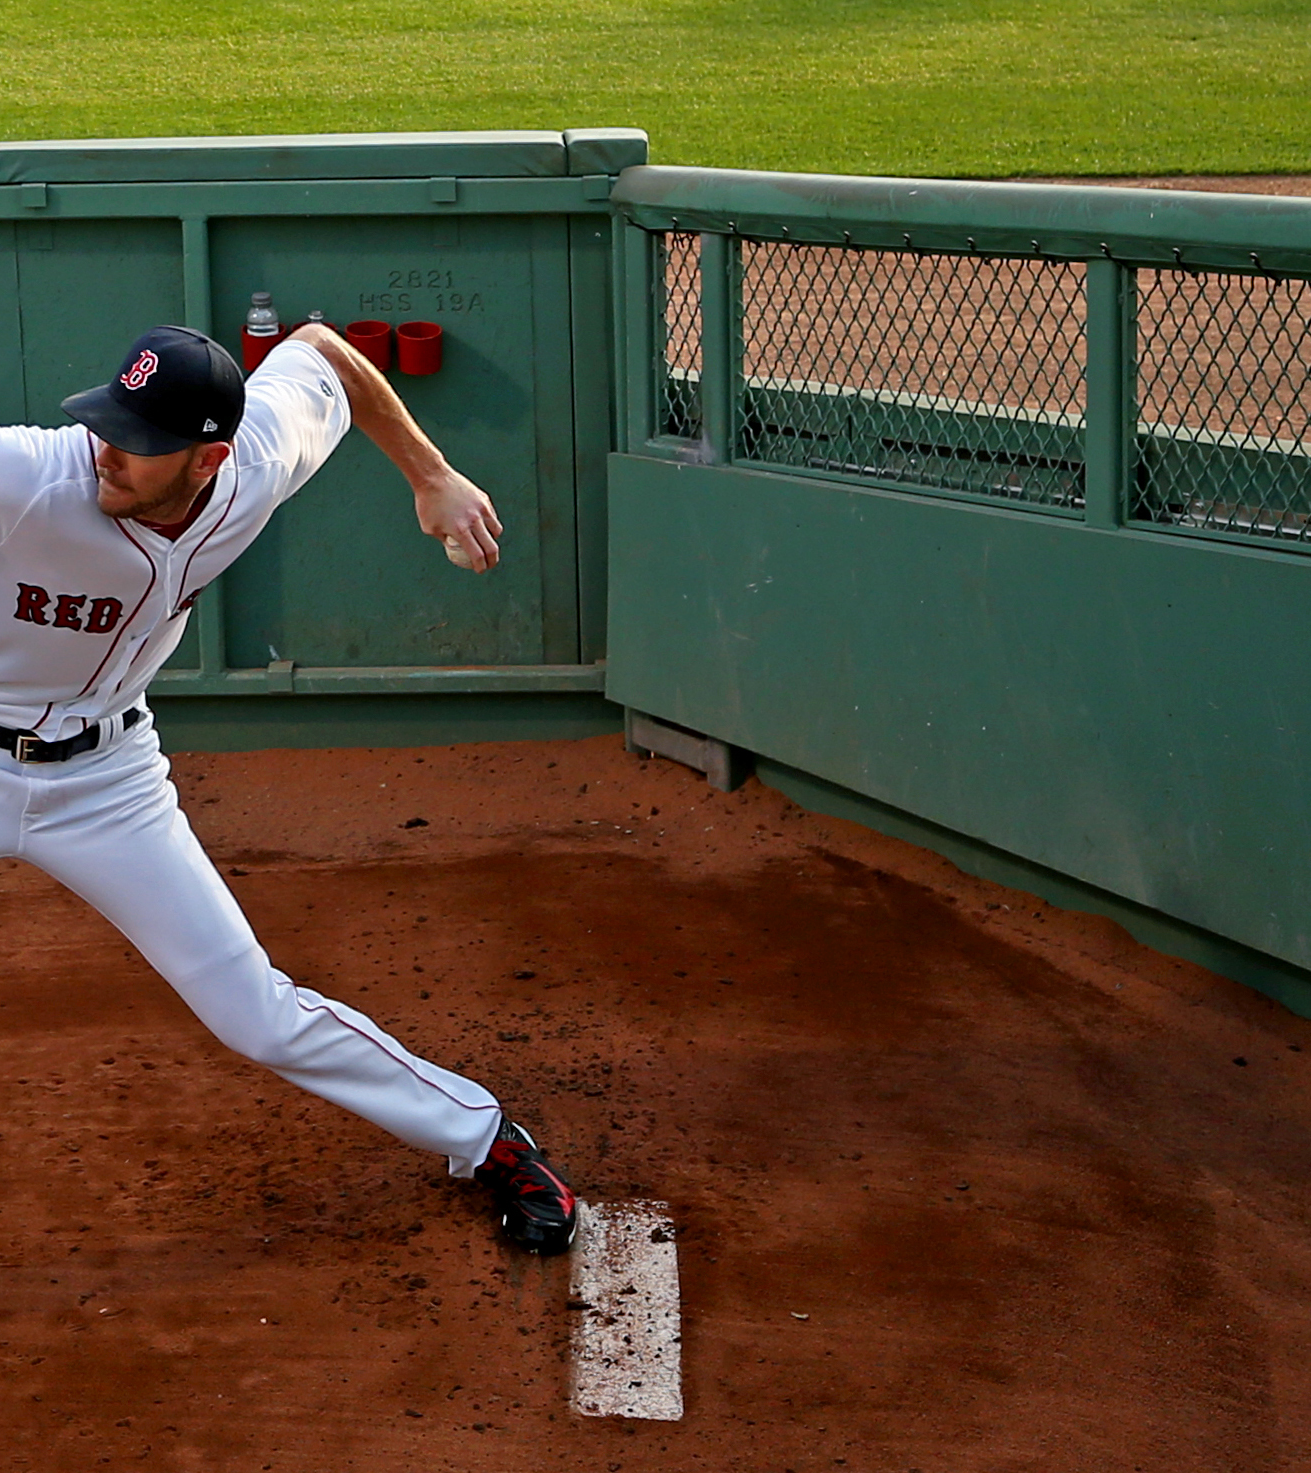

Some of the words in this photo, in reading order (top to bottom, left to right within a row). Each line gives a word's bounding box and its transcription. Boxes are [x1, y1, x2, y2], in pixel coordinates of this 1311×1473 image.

[388, 270, 455, 289] 2821
[359, 293, 412, 313] HSS
[436, 293, 484, 313] 19A
[119, 349, 159, 391] B
[13, 581, 124, 635] RED
